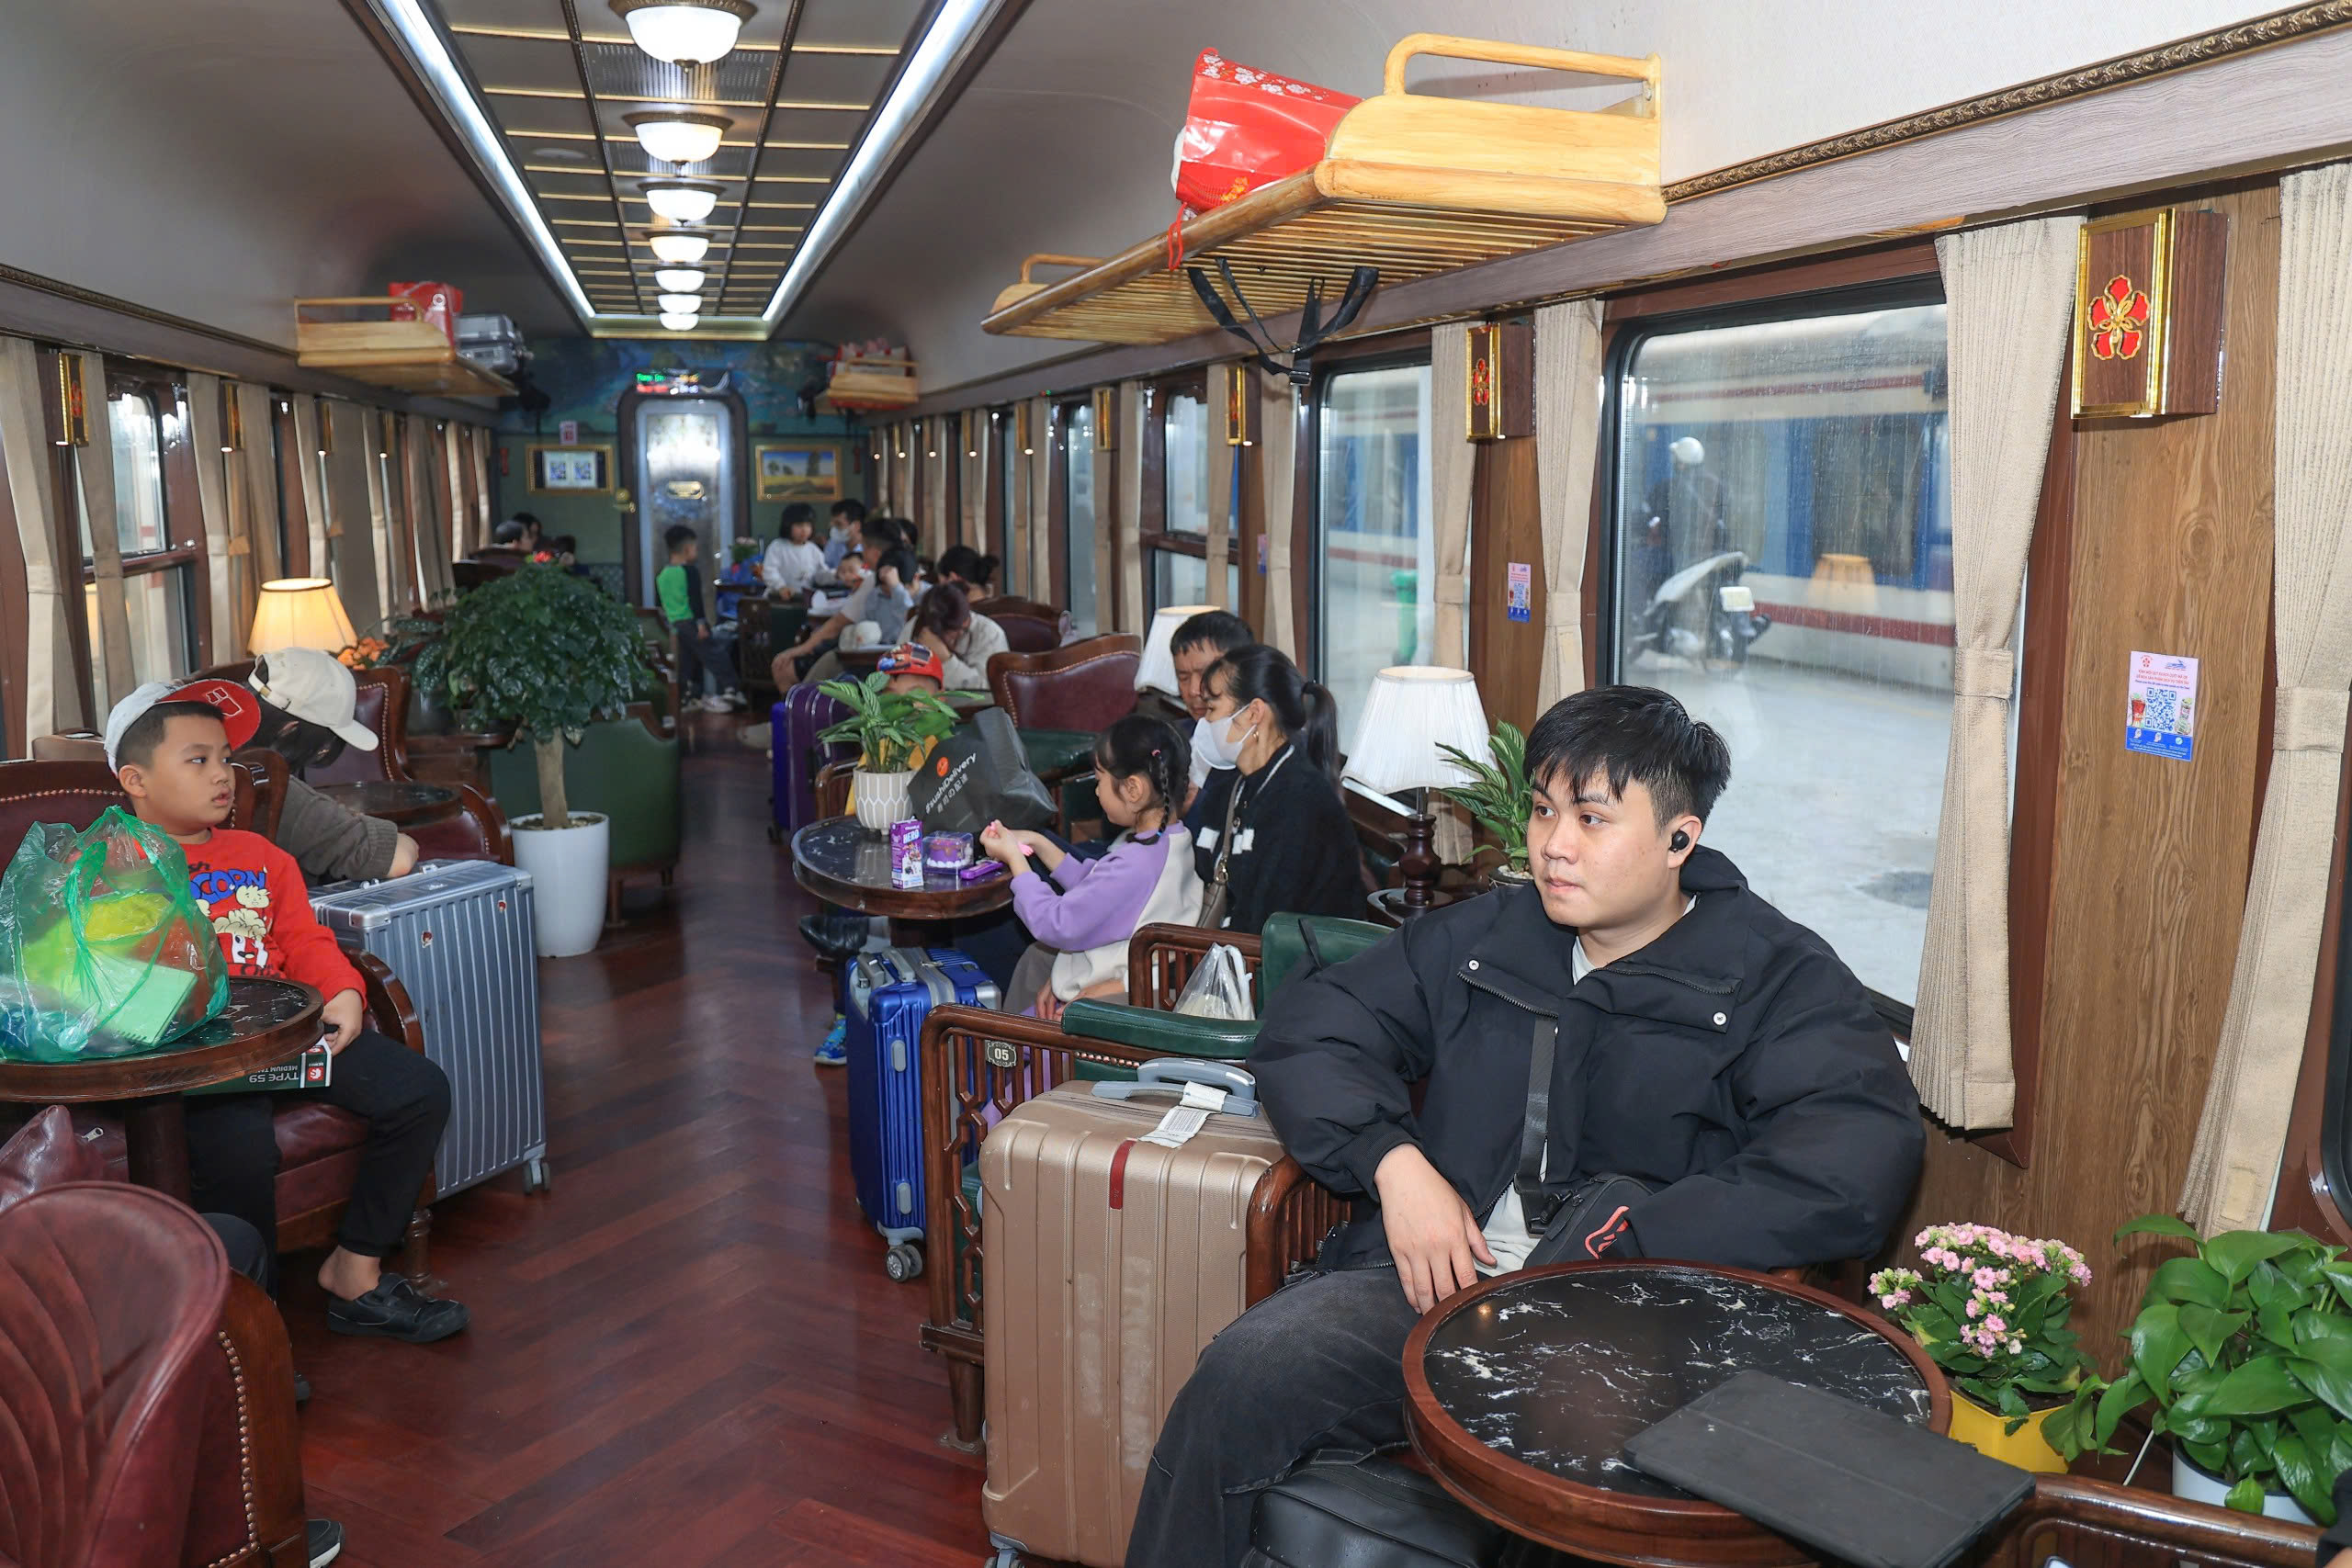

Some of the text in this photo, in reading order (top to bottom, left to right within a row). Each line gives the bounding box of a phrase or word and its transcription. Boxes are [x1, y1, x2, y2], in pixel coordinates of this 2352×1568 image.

[903, 829, 920, 844] HERO
[994, 1048, 1009, 1060] 05
[249, 1071, 300, 1083] TYPE 59
